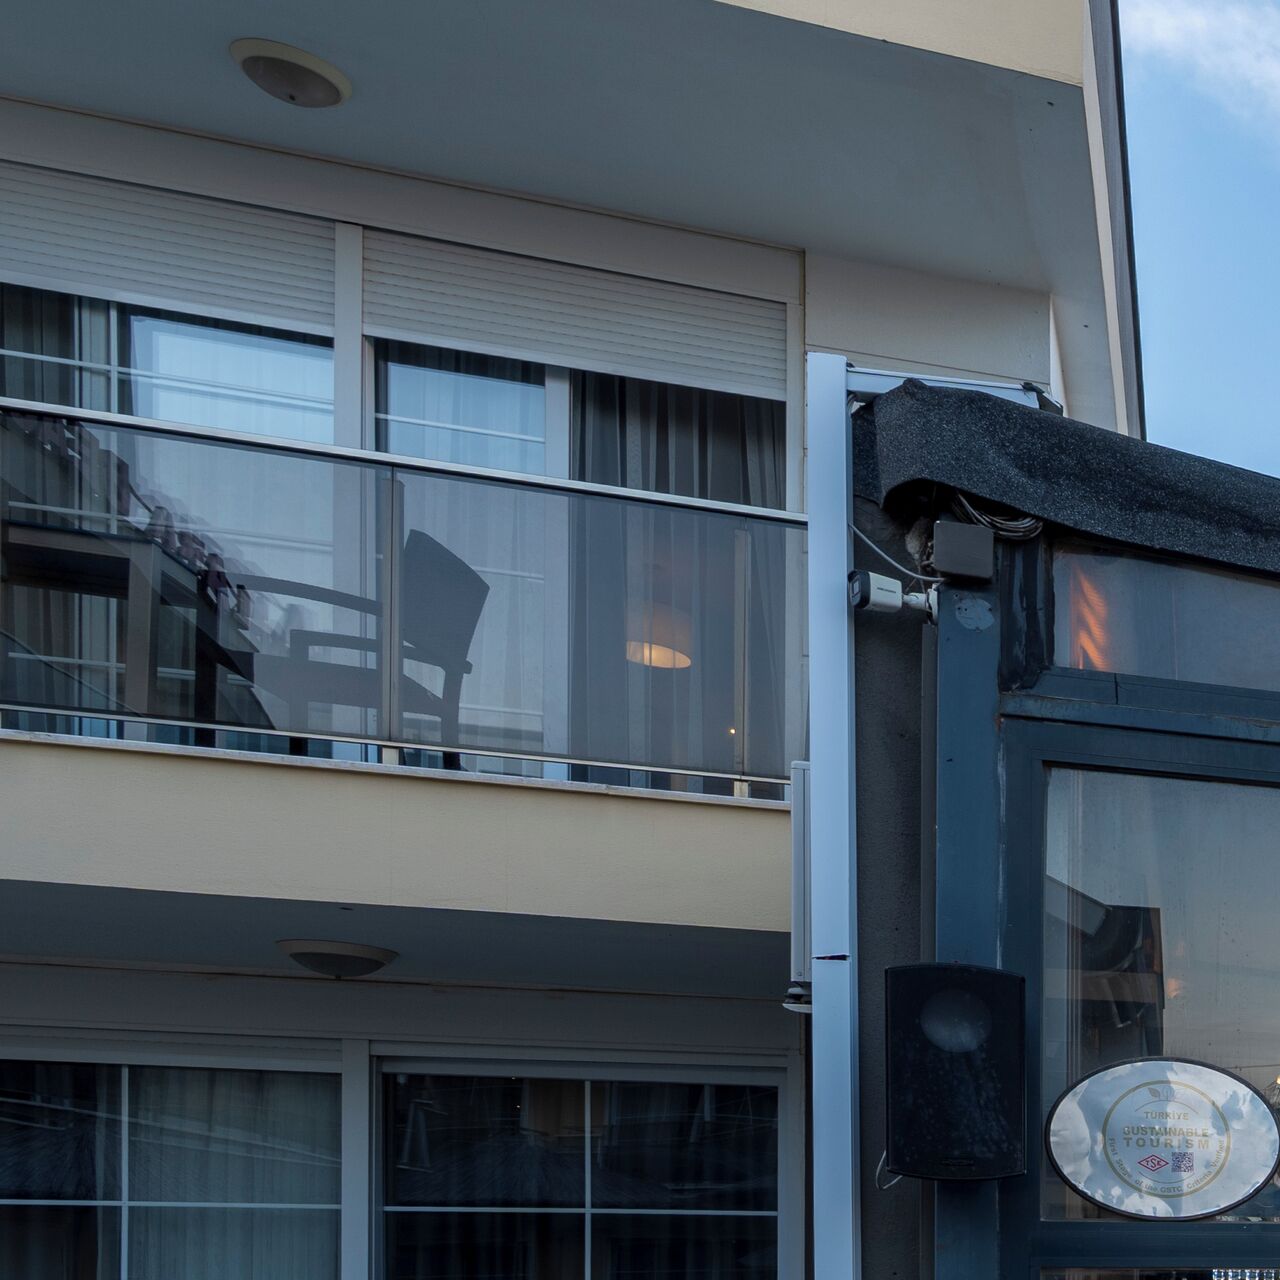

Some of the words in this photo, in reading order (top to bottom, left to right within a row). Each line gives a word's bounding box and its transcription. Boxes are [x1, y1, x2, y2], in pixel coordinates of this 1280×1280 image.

[1144, 1110, 1189, 1120] TÜRKİYE
[1123, 1126, 1209, 1138] SUSTAINABLE
[1124, 1137, 1210, 1149] TOURISM
